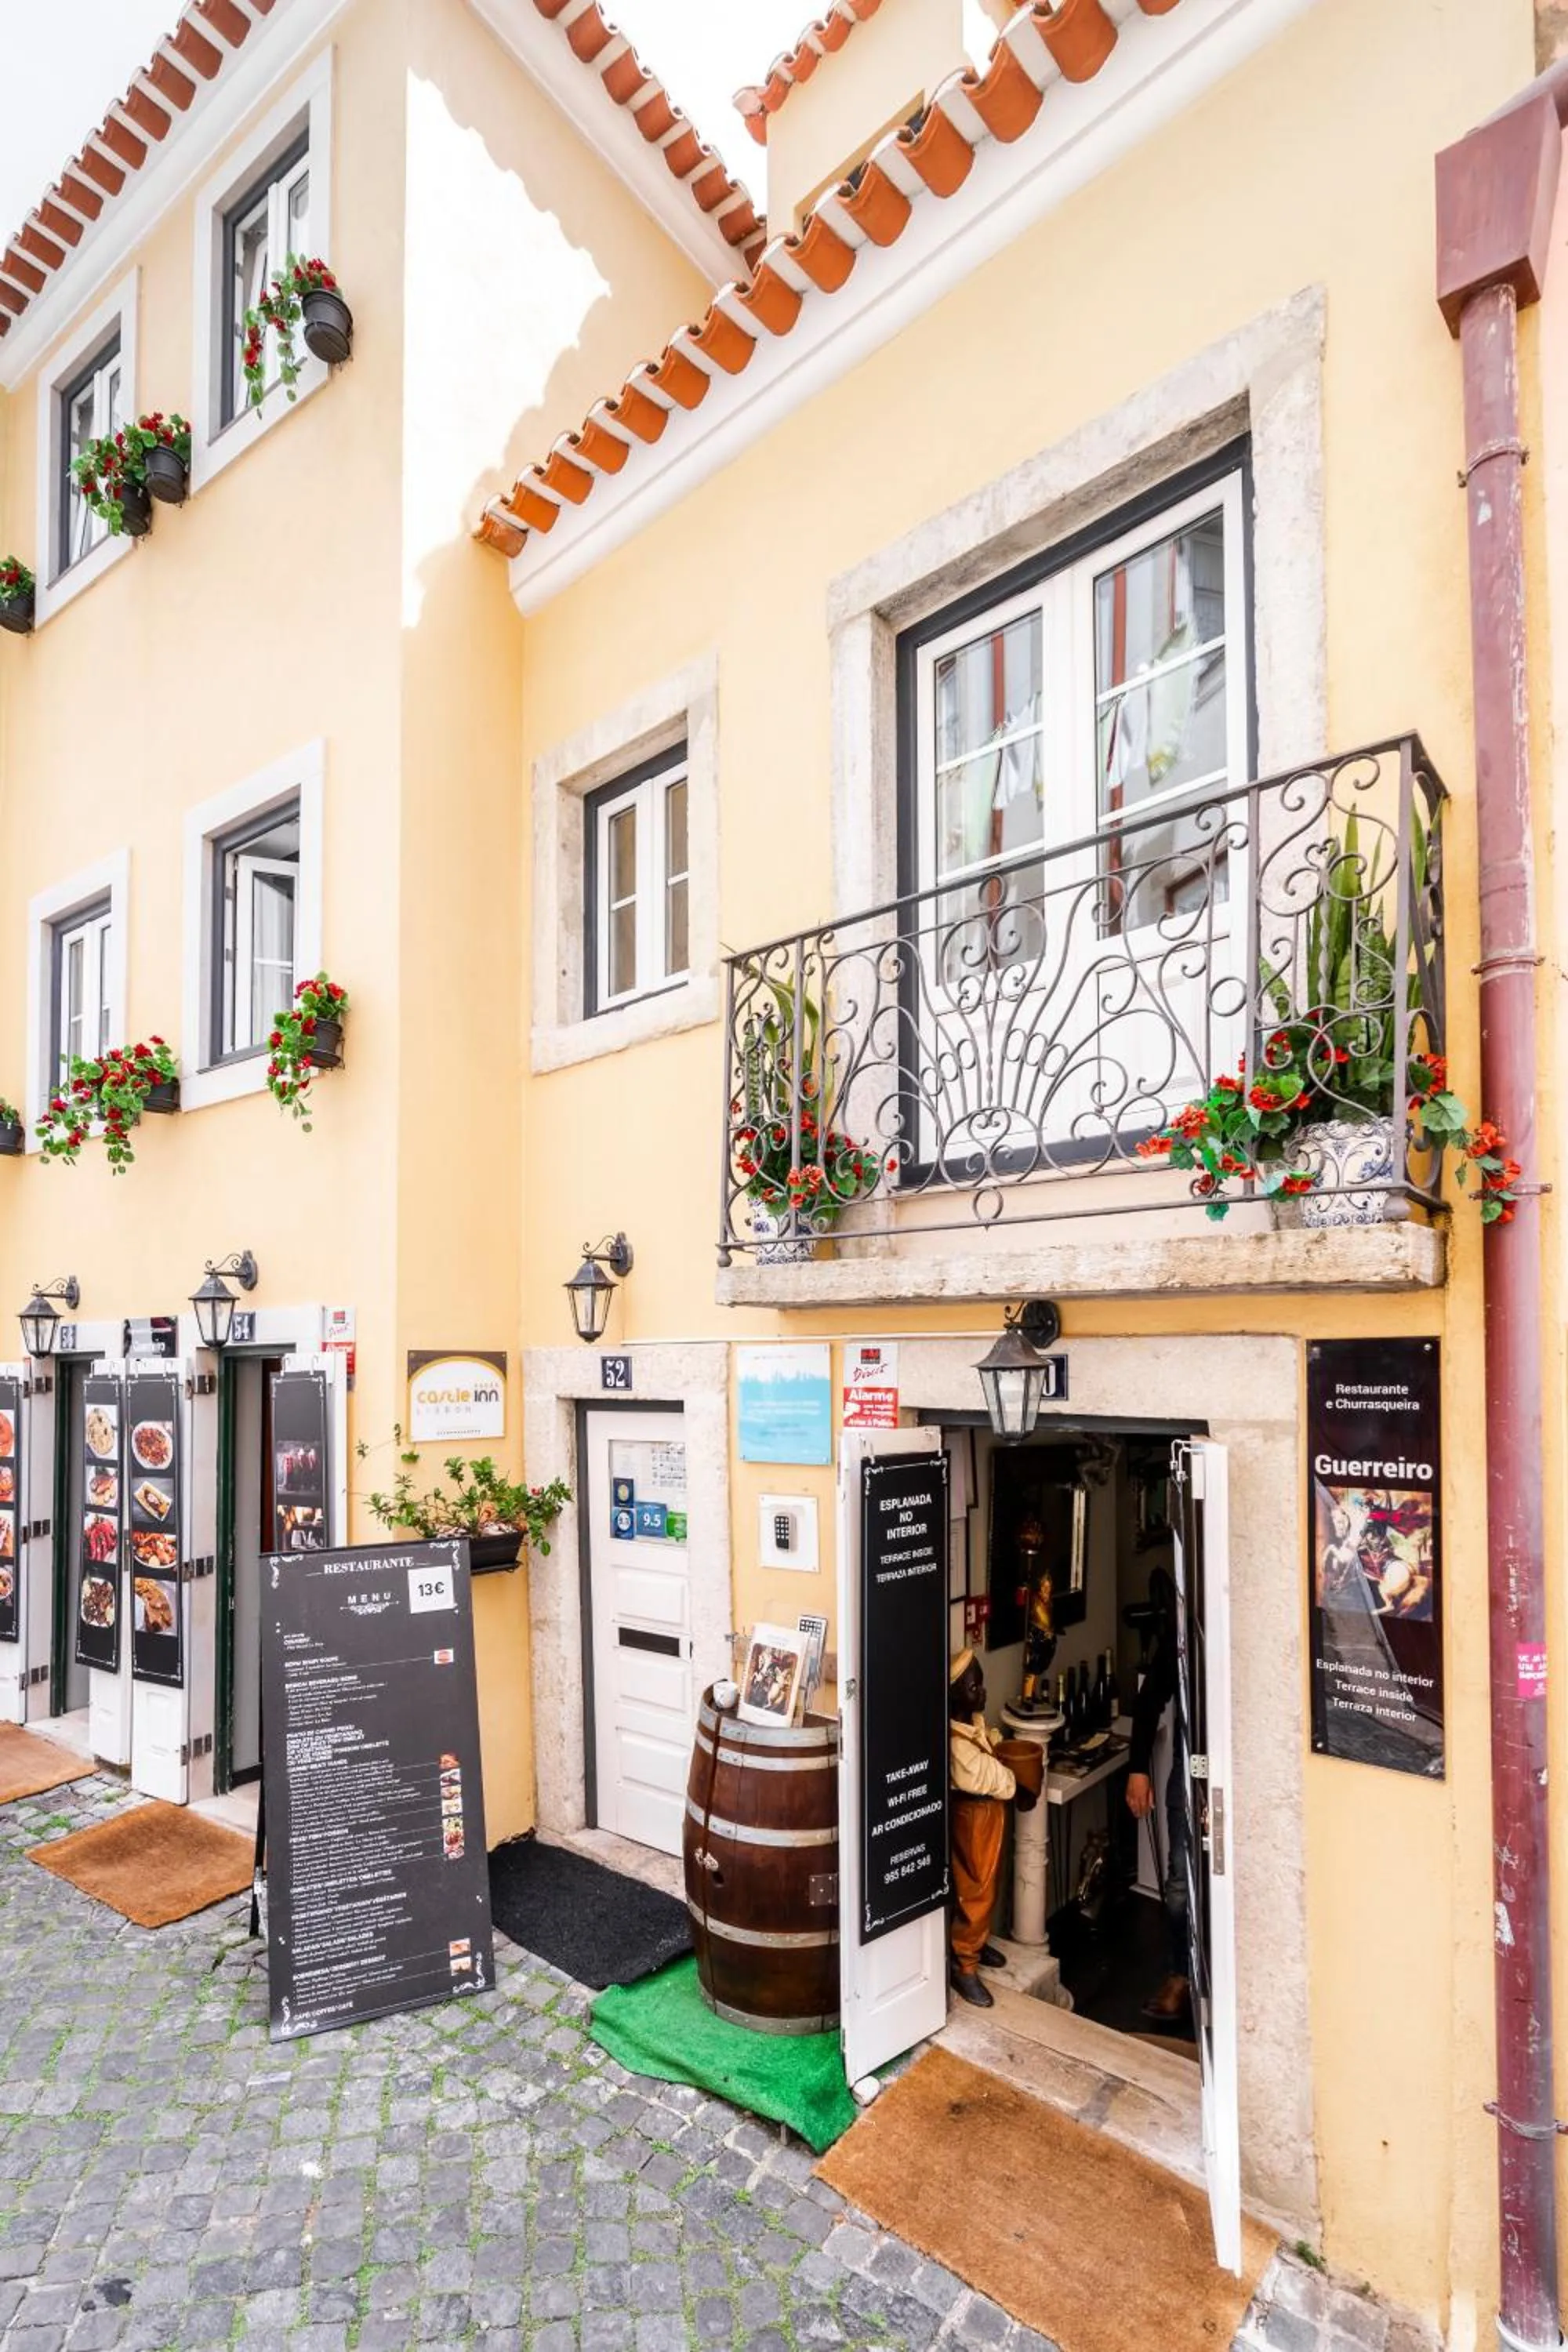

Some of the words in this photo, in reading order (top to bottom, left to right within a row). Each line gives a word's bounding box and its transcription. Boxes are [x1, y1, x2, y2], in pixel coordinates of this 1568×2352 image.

[235, 1315, 249, 1340] 54
[605, 1359, 626, 1387] 52
[474, 1389, 499, 1403] inn
[849, 1388, 894, 1403] Alarme
[1335, 1384, 1409, 1395] Restaurante
[1325, 1399, 1334, 1410] e
[1335, 1398, 1421, 1412] Churrasqueira
[1314, 1454, 1433, 1480] Guerreiro
[880, 1494, 932, 1511] ESPLANADA
[899, 1512, 913, 1523] NO
[887, 1523, 927, 1540] INTERIOR
[324, 1556, 415, 1574] RESTAURANTE
[880, 1550, 911, 1565] TERRACE
[907, 1563, 938, 1577] INTERIOR
[347, 1592, 391, 1604] MENU
[1316, 1658, 1372, 1677] Esplanada
[1374, 1670, 1390, 1680] no
[1392, 1671, 1434, 1687] interior
[1335, 1679, 1376, 1696] Terrace
[1378, 1689, 1414, 1702] inside
[1333, 1697, 1373, 1713] Terraza
[1376, 1704, 1417, 1722] interior
[886, 1759, 930, 1784] TAKE-AWAY
[907, 1784, 928, 1802] FREE
[871, 1822, 884, 1838] AR
[884, 1801, 942, 1831] CONDICIONADO
